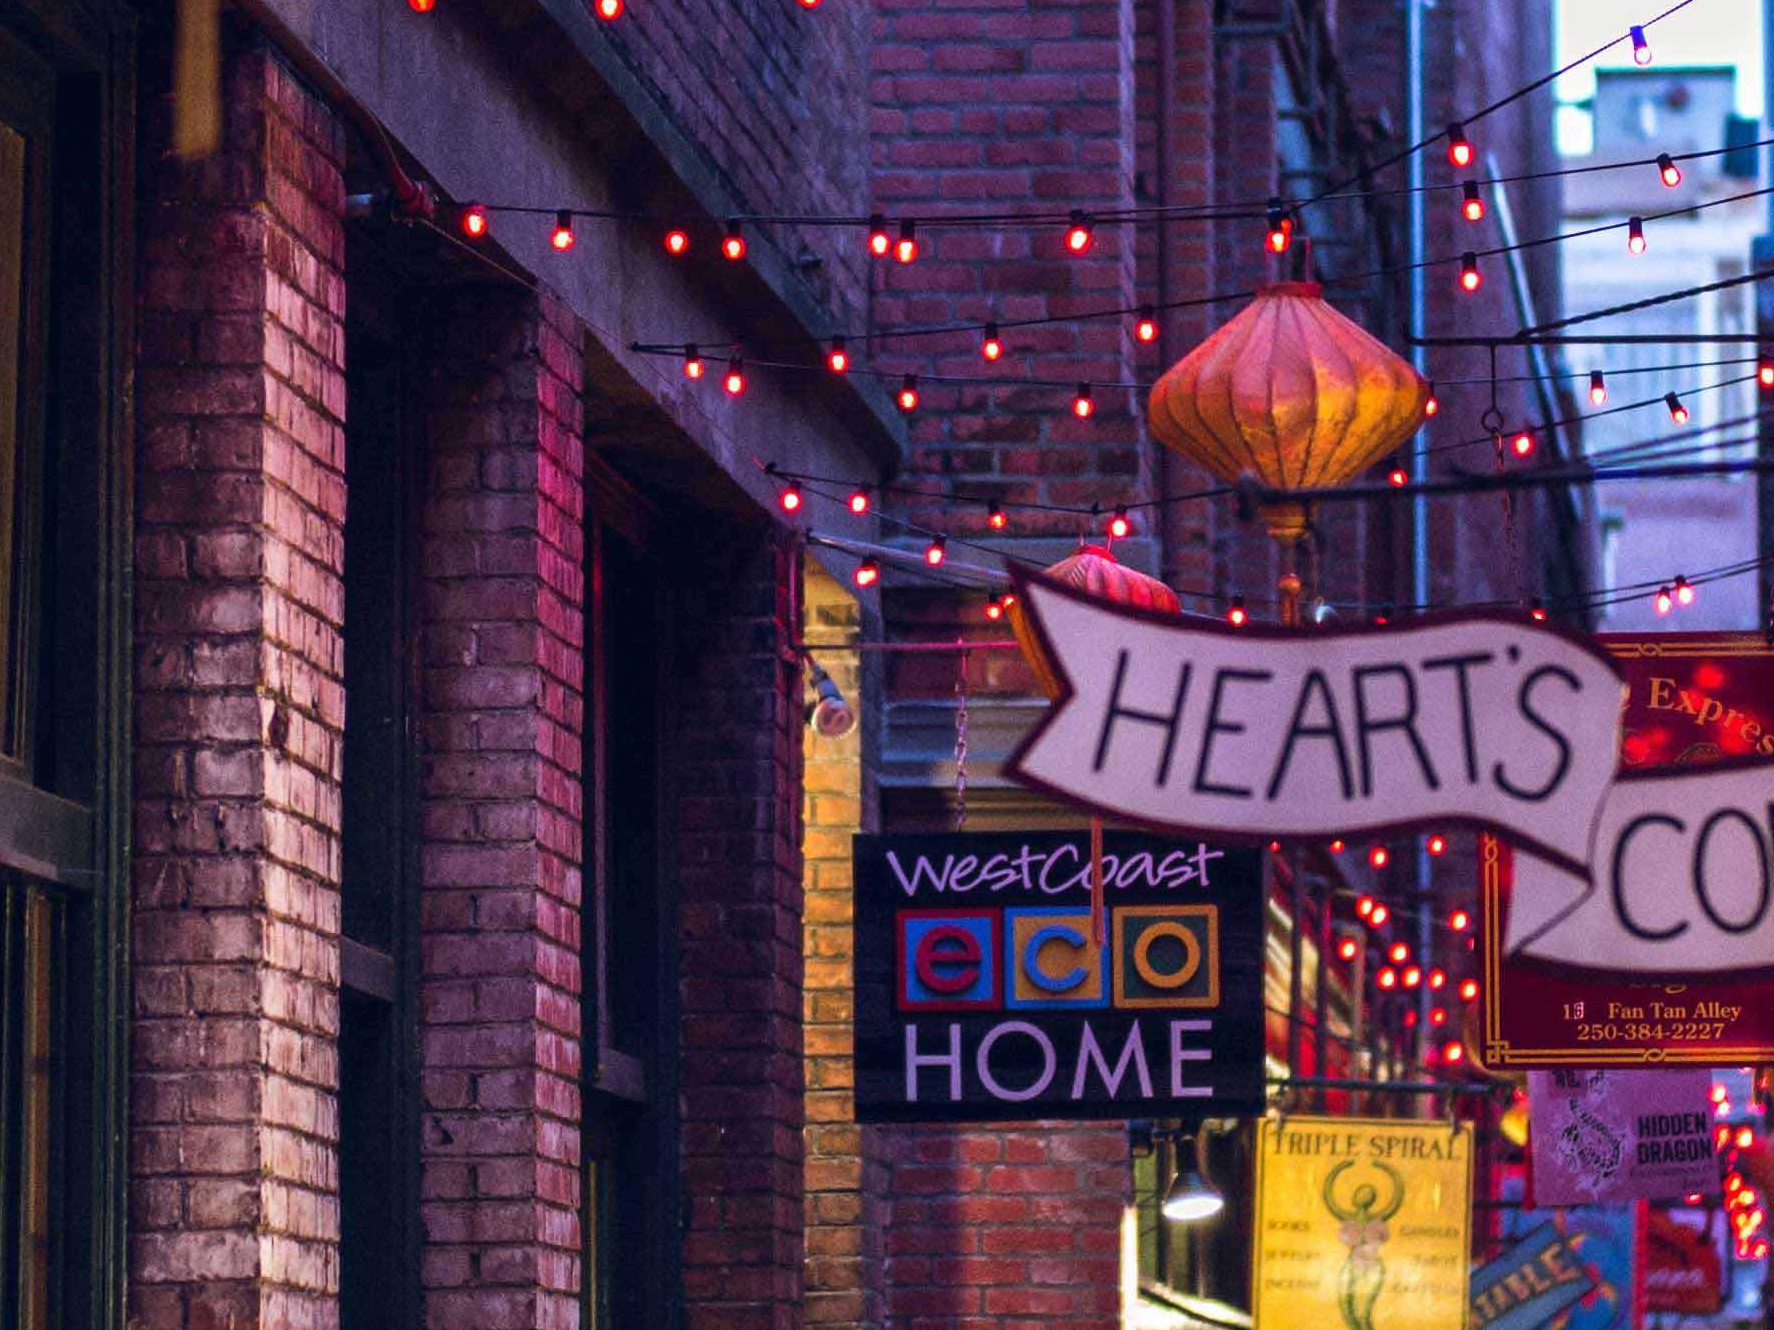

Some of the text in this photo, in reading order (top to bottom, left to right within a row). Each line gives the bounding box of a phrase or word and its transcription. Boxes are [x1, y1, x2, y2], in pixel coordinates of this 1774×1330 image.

[1090, 642, 1584, 803] HEART'S
[915, 921, 1202, 994] eco
[1608, 1002, 1644, 1020] Fan
[1650, 1002, 1686, 1020] Tan
[1692, 1001, 1741, 1022] Alley
[1577, 1022, 1725, 1042] 250-384-2227
[905, 1017, 1214, 1101] HOME
[1638, 1111, 1708, 1138] HIDDEN
[1269, 1133, 1462, 1160] TRIPLE SPIRAL
[1637, 1137, 1713, 1166] DRAGON
